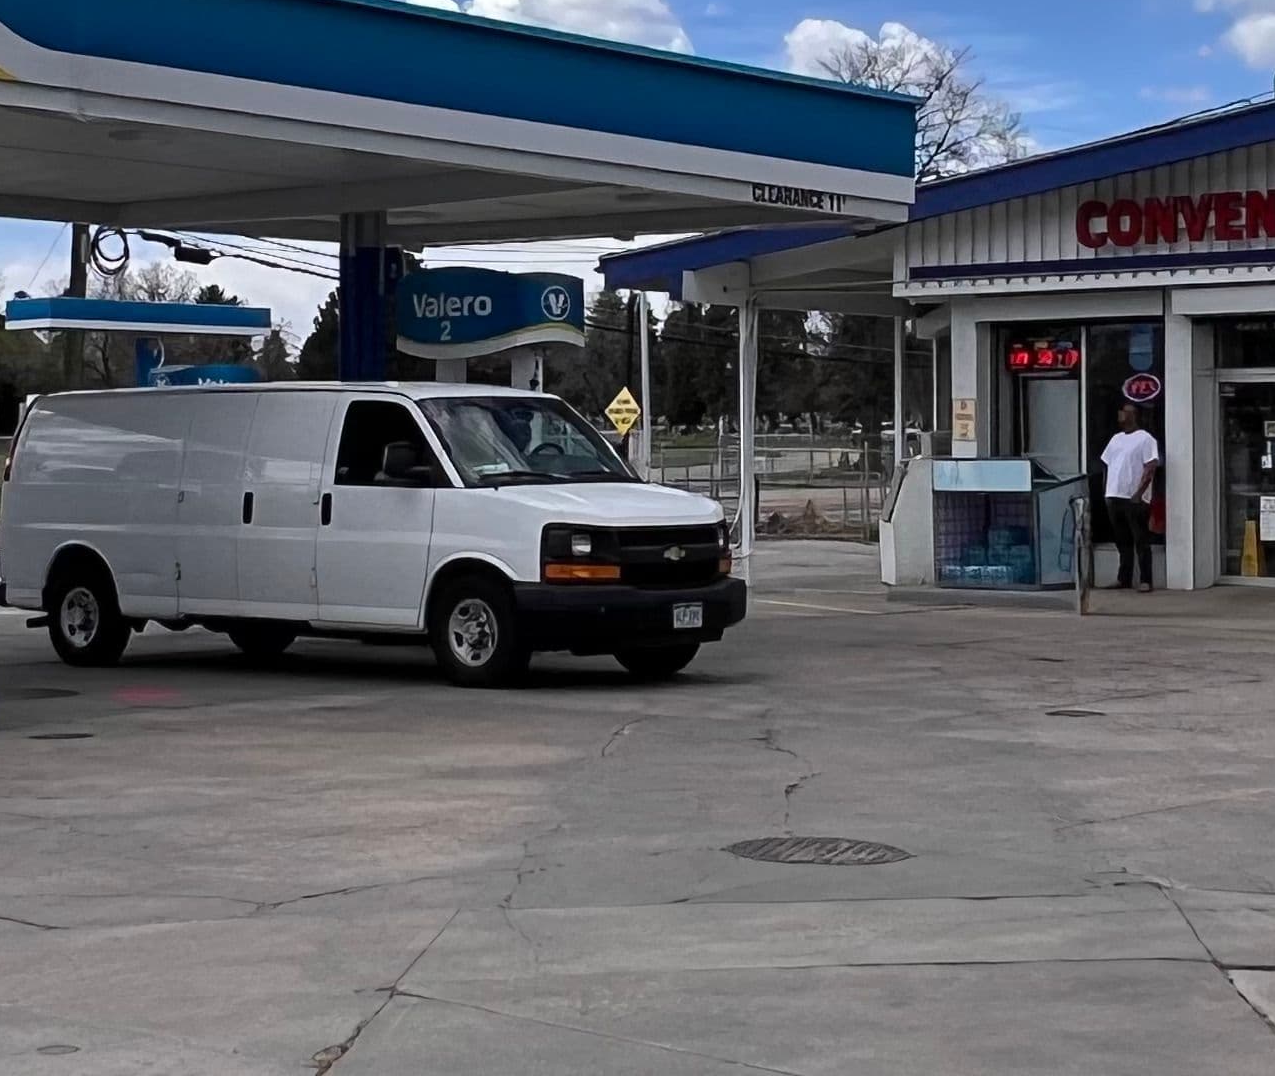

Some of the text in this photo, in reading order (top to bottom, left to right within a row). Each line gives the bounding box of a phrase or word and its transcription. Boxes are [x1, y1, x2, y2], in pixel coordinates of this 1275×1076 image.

[751, 183, 824, 210] CLEARANCE
[412, 292, 492, 318] Valero
[440, 320, 452, 341] 2
